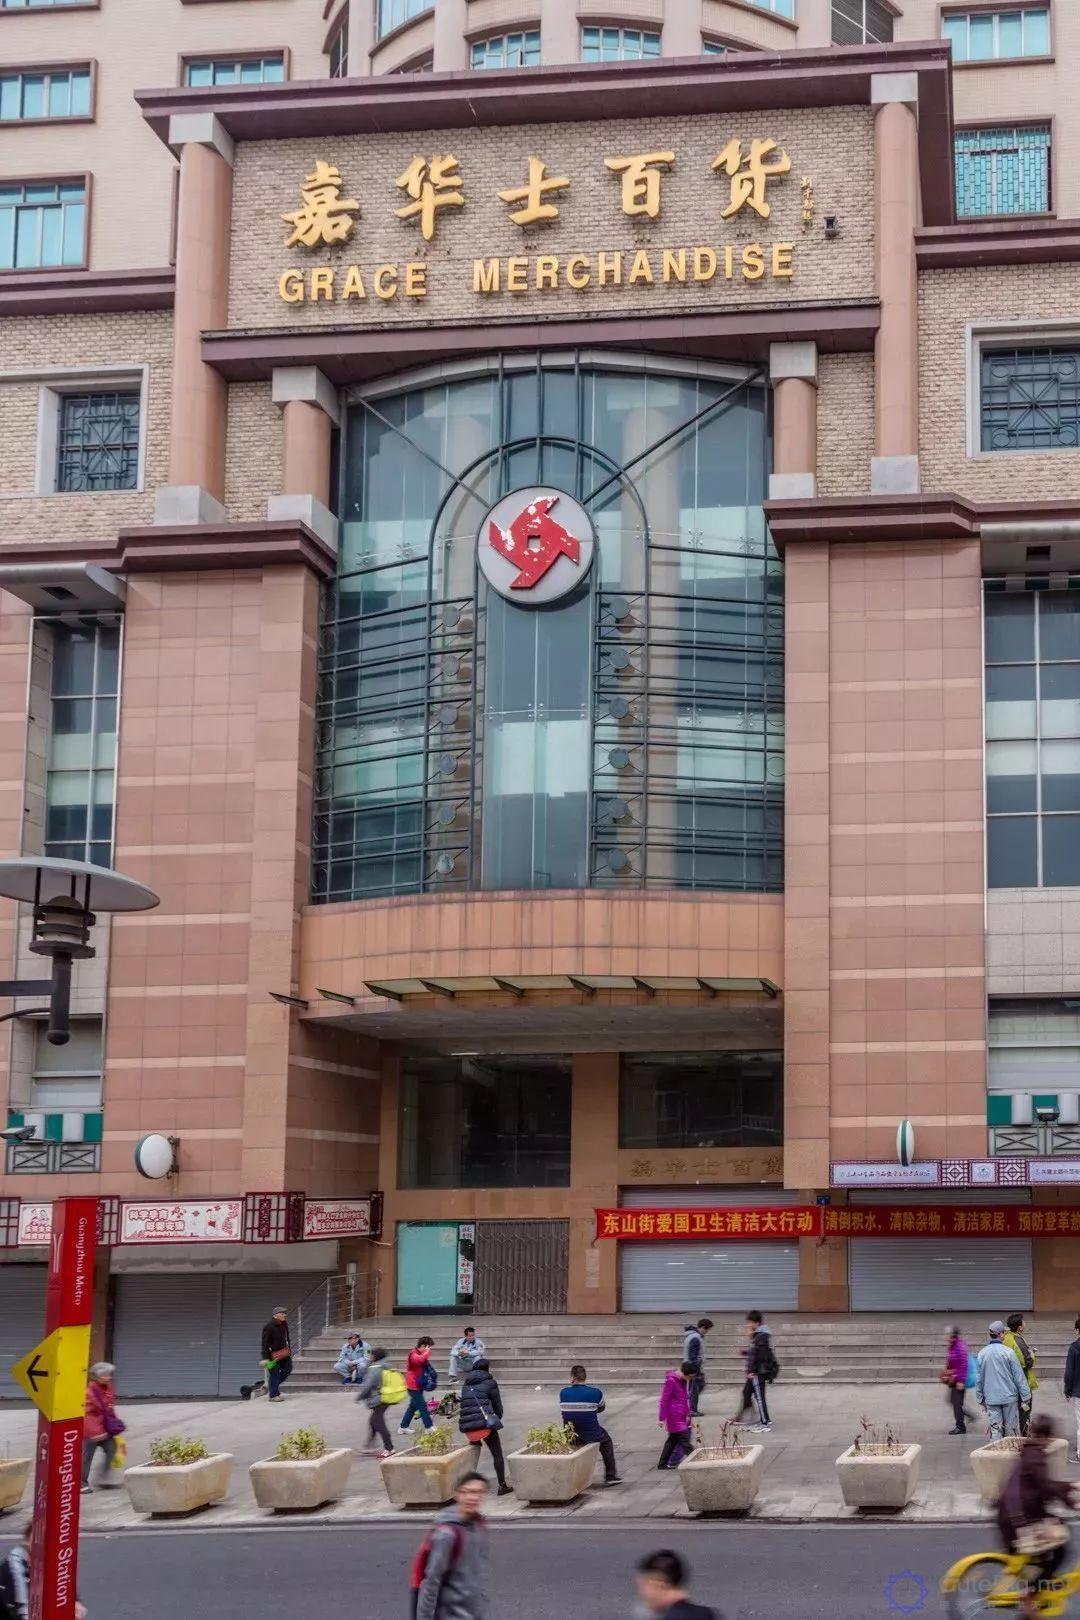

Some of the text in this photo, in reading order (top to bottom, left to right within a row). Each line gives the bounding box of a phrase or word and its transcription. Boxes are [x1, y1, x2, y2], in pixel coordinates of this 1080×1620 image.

[280, 138, 792, 249] 嘉华士百货
[279, 241, 795, 304] GRACE MERCHANDISE
[74, 1216, 88, 1306] Guangzhou Metro
[603, 1211, 813, 1234] 东山街爱国卫生清洁大行动
[55, 1429, 79, 1608] Dongshankou Station
